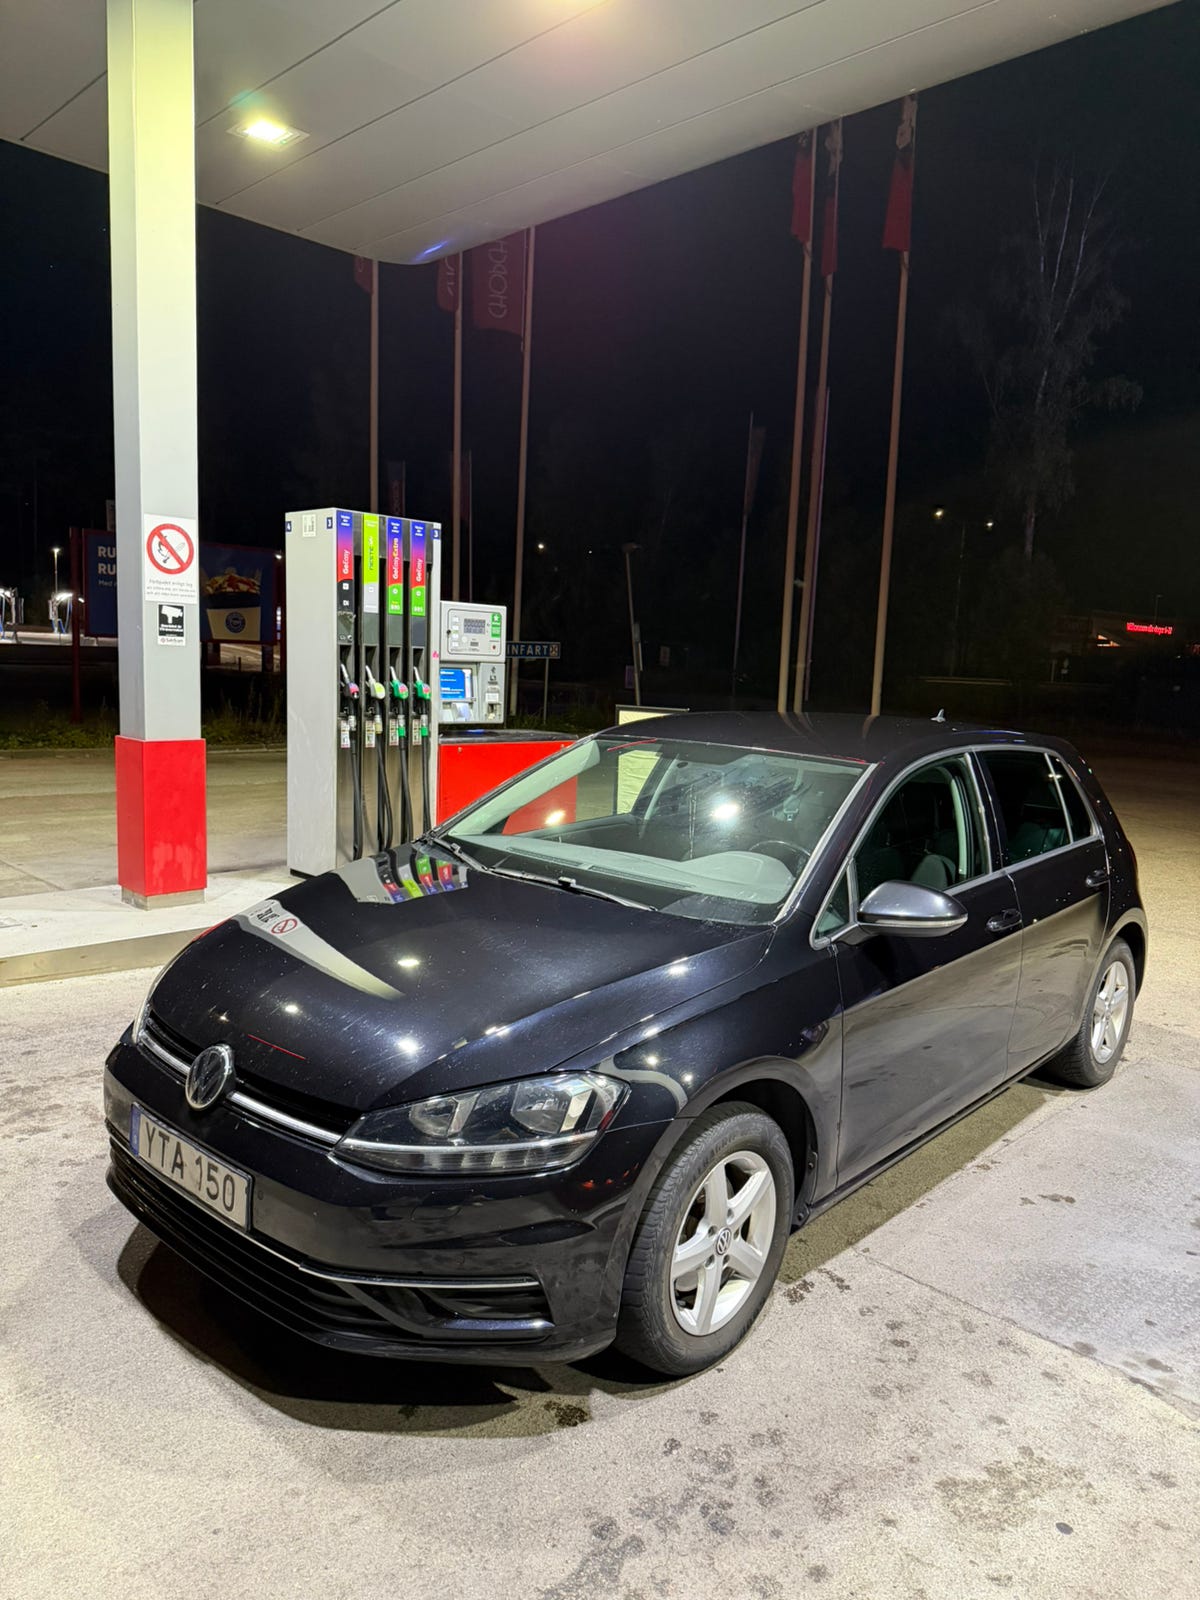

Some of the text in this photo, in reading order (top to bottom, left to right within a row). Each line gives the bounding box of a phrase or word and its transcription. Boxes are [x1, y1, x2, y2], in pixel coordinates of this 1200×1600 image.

[97, 546, 117, 558] RU
[342, 549, 350, 575] GoEasy
[97, 563, 117, 575] RU
[507, 644, 548, 656] INFART
[145, 1121, 235, 1212] YTA 150
